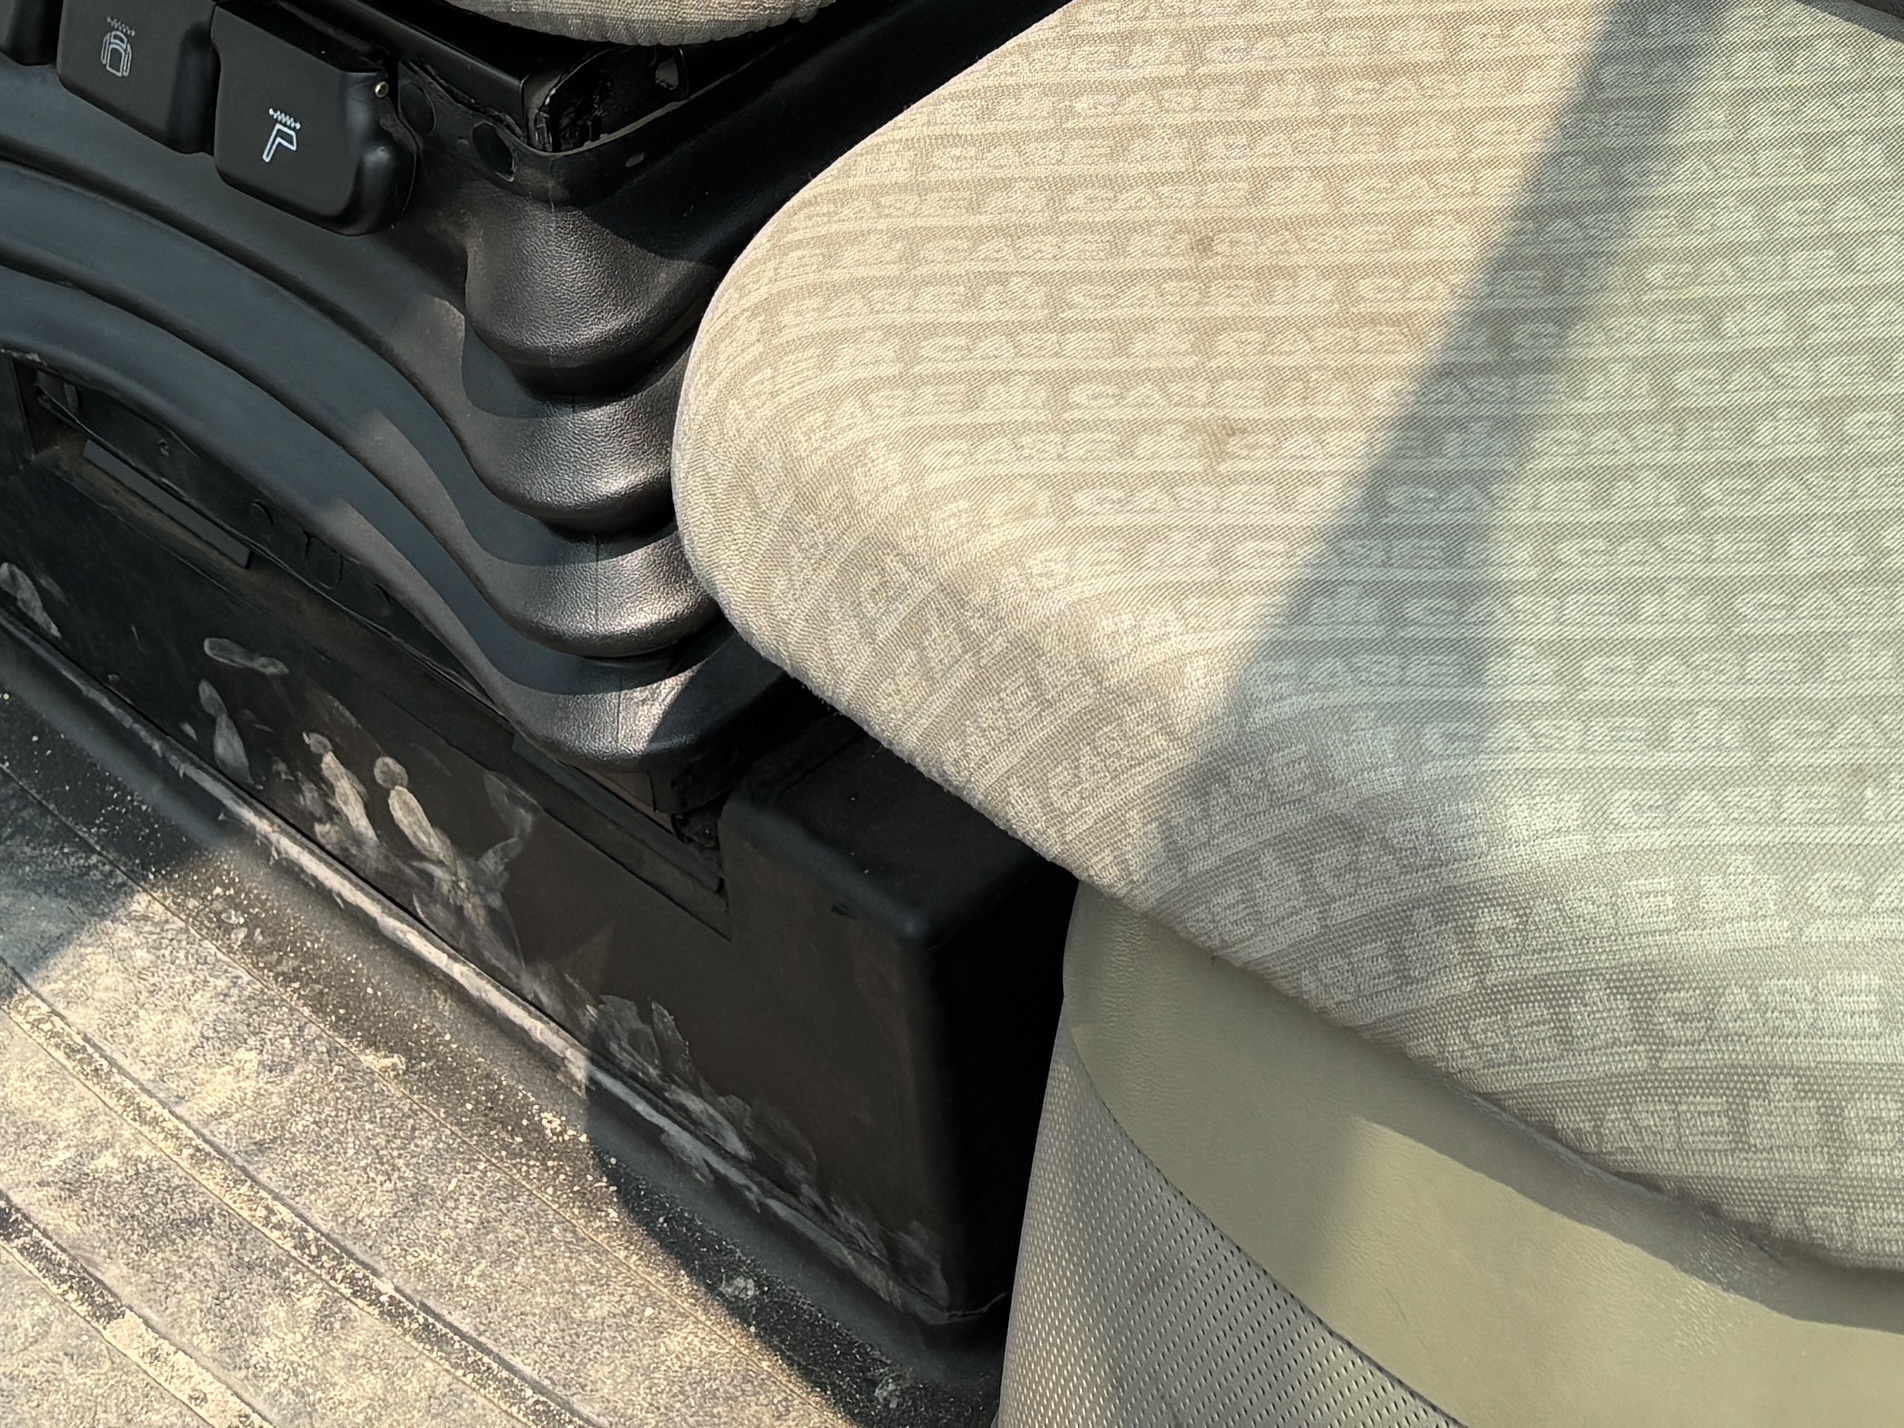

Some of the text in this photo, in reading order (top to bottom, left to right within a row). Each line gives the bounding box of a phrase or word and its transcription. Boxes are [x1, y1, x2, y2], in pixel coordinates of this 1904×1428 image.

[1583, 650, 1805, 688] CASE
[1422, 717, 1649, 754] CASE
[1610, 782, 1842, 824] CASE
[1654, 972, 1883, 1040] CASE
